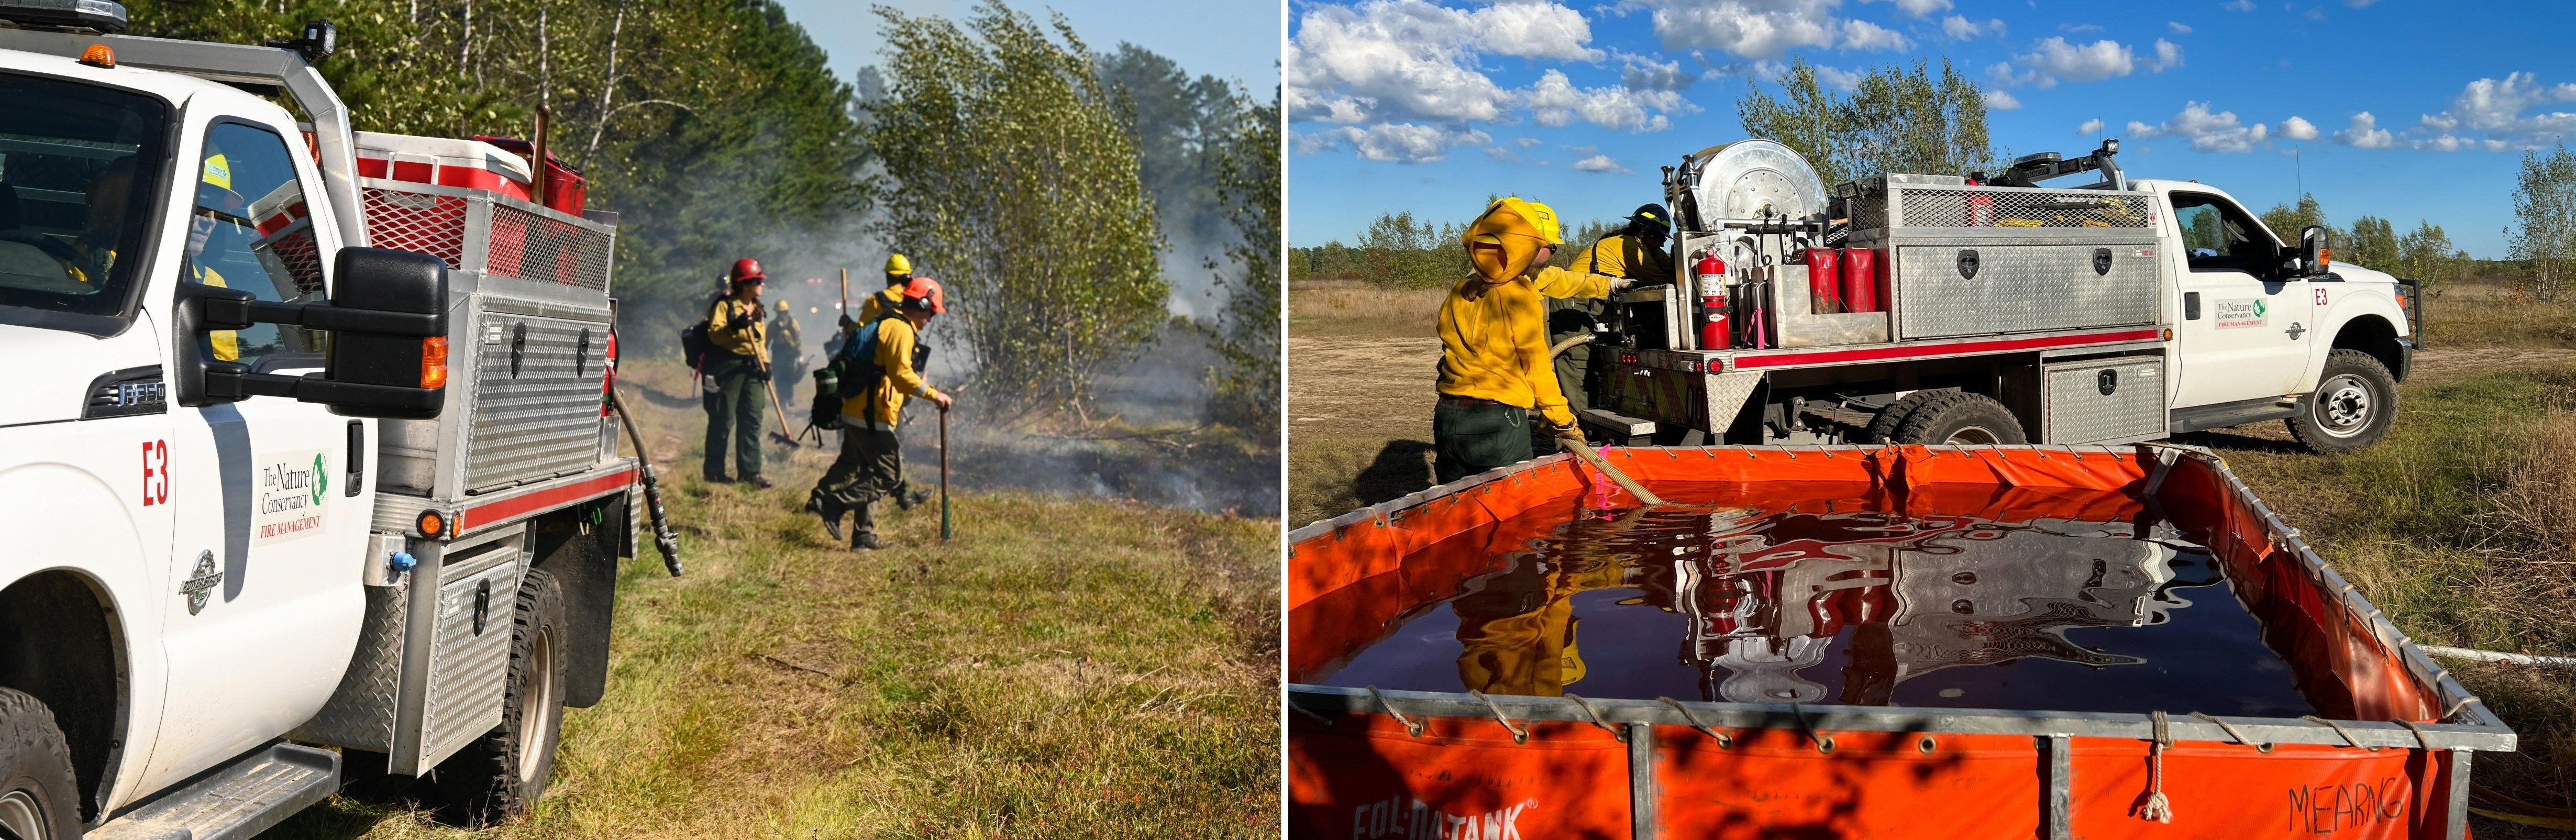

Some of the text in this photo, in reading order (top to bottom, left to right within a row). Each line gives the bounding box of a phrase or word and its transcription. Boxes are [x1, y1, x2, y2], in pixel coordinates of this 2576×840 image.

[2227, 302, 2251, 312] Nature
[2315, 288, 2328, 305] E3
[2217, 312, 2251, 320] Conservancy
[142, 439, 168, 506] E3
[263, 463, 310, 491] The Nature
[262, 492, 308, 517] Conservancy
[260, 515, 321, 538] FIRE MANAGEMENT
[2288, 777, 2404, 834] MEARNG
